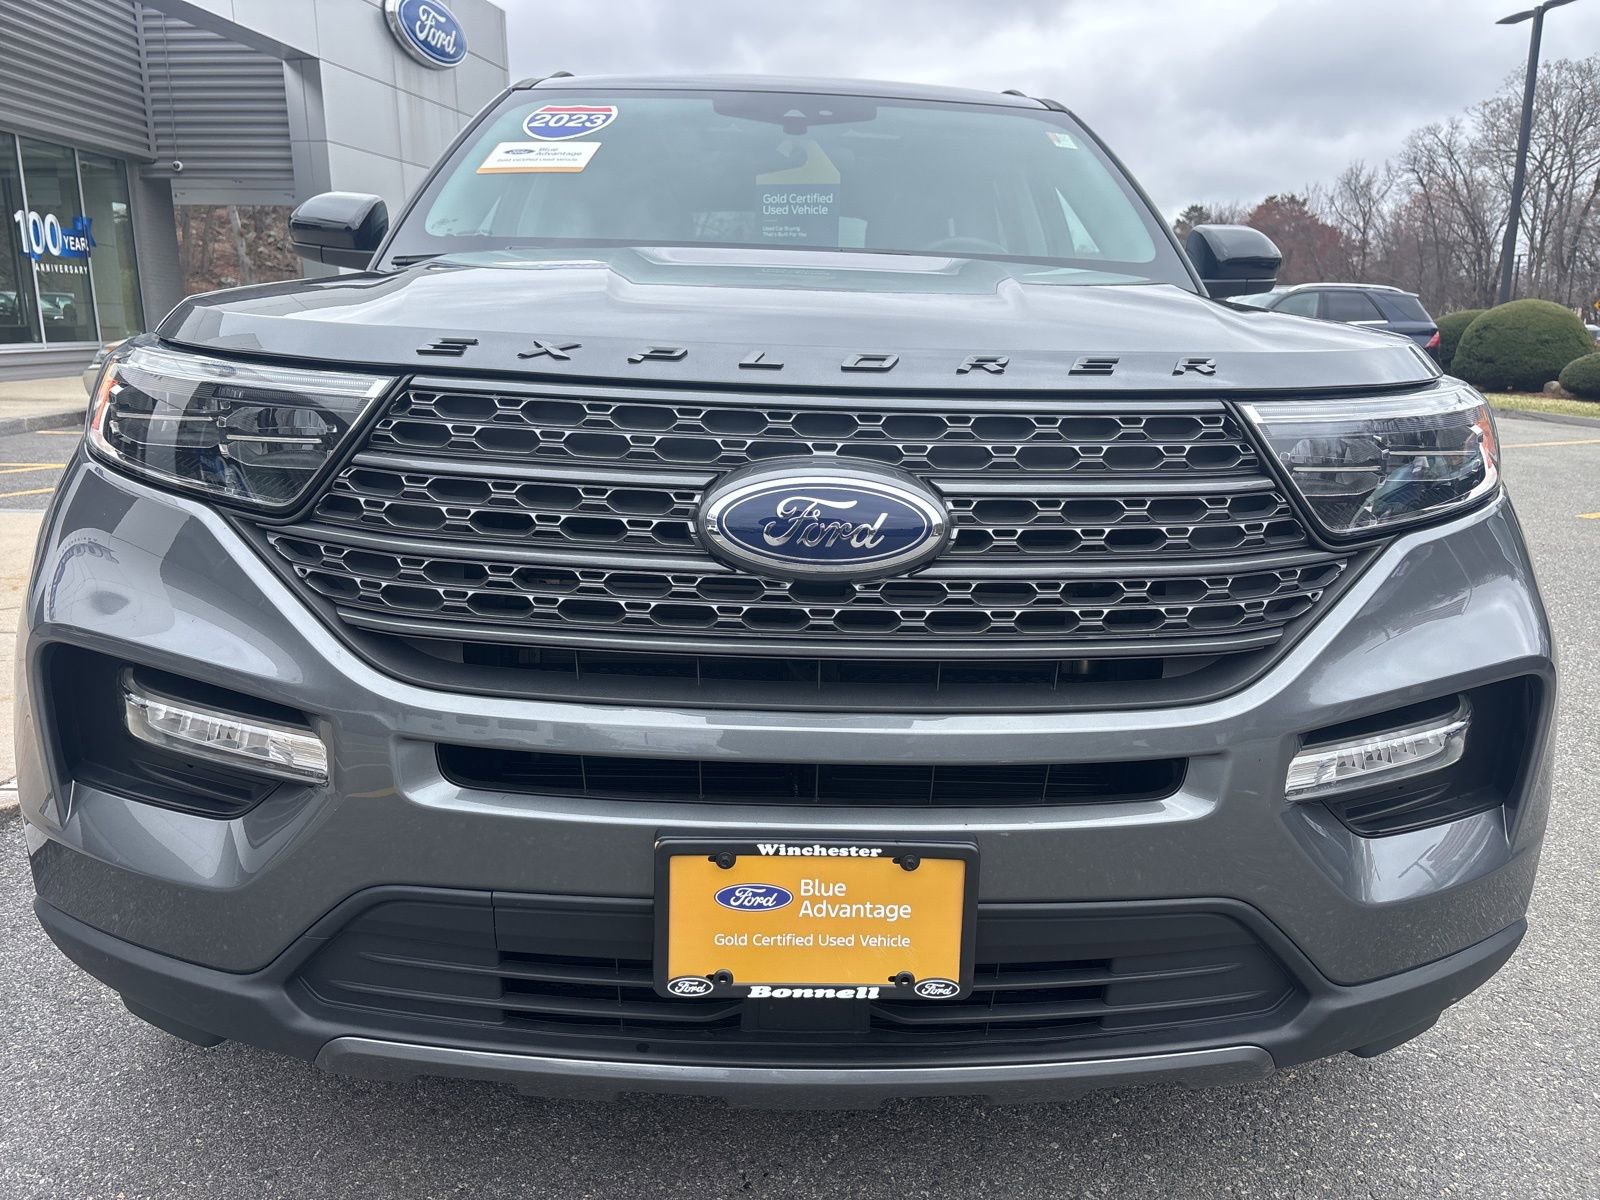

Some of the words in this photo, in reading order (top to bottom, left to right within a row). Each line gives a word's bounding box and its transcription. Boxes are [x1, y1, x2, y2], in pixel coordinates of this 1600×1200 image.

[416, 5, 456, 54] Ford
[527, 114, 606, 127] 2023
[762, 193, 787, 204] Gold
[789, 193, 833, 204] Certified
[762, 205, 788, 215] Used
[791, 205, 828, 215] Vehicle
[14, 210, 62, 256] 100
[35, 263, 88, 274] ANNIVERSARY
[415, 337, 1218, 377] EXPLORER
[762, 496, 889, 549] Ford
[756, 843, 883, 858] Winchester
[800, 879, 847, 897] Blue
[729, 885, 777, 908] Ford
[799, 900, 912, 922] Advantage
[714, 934, 748, 947] Gold
[752, 933, 813, 947] Certified
[818, 934, 855, 947] Used
[860, 934, 911, 948] Vehicle
[674, 980, 707, 996] Ford
[747, 985, 880, 1000] Bonnell
[921, 982, 953, 996] Ford
